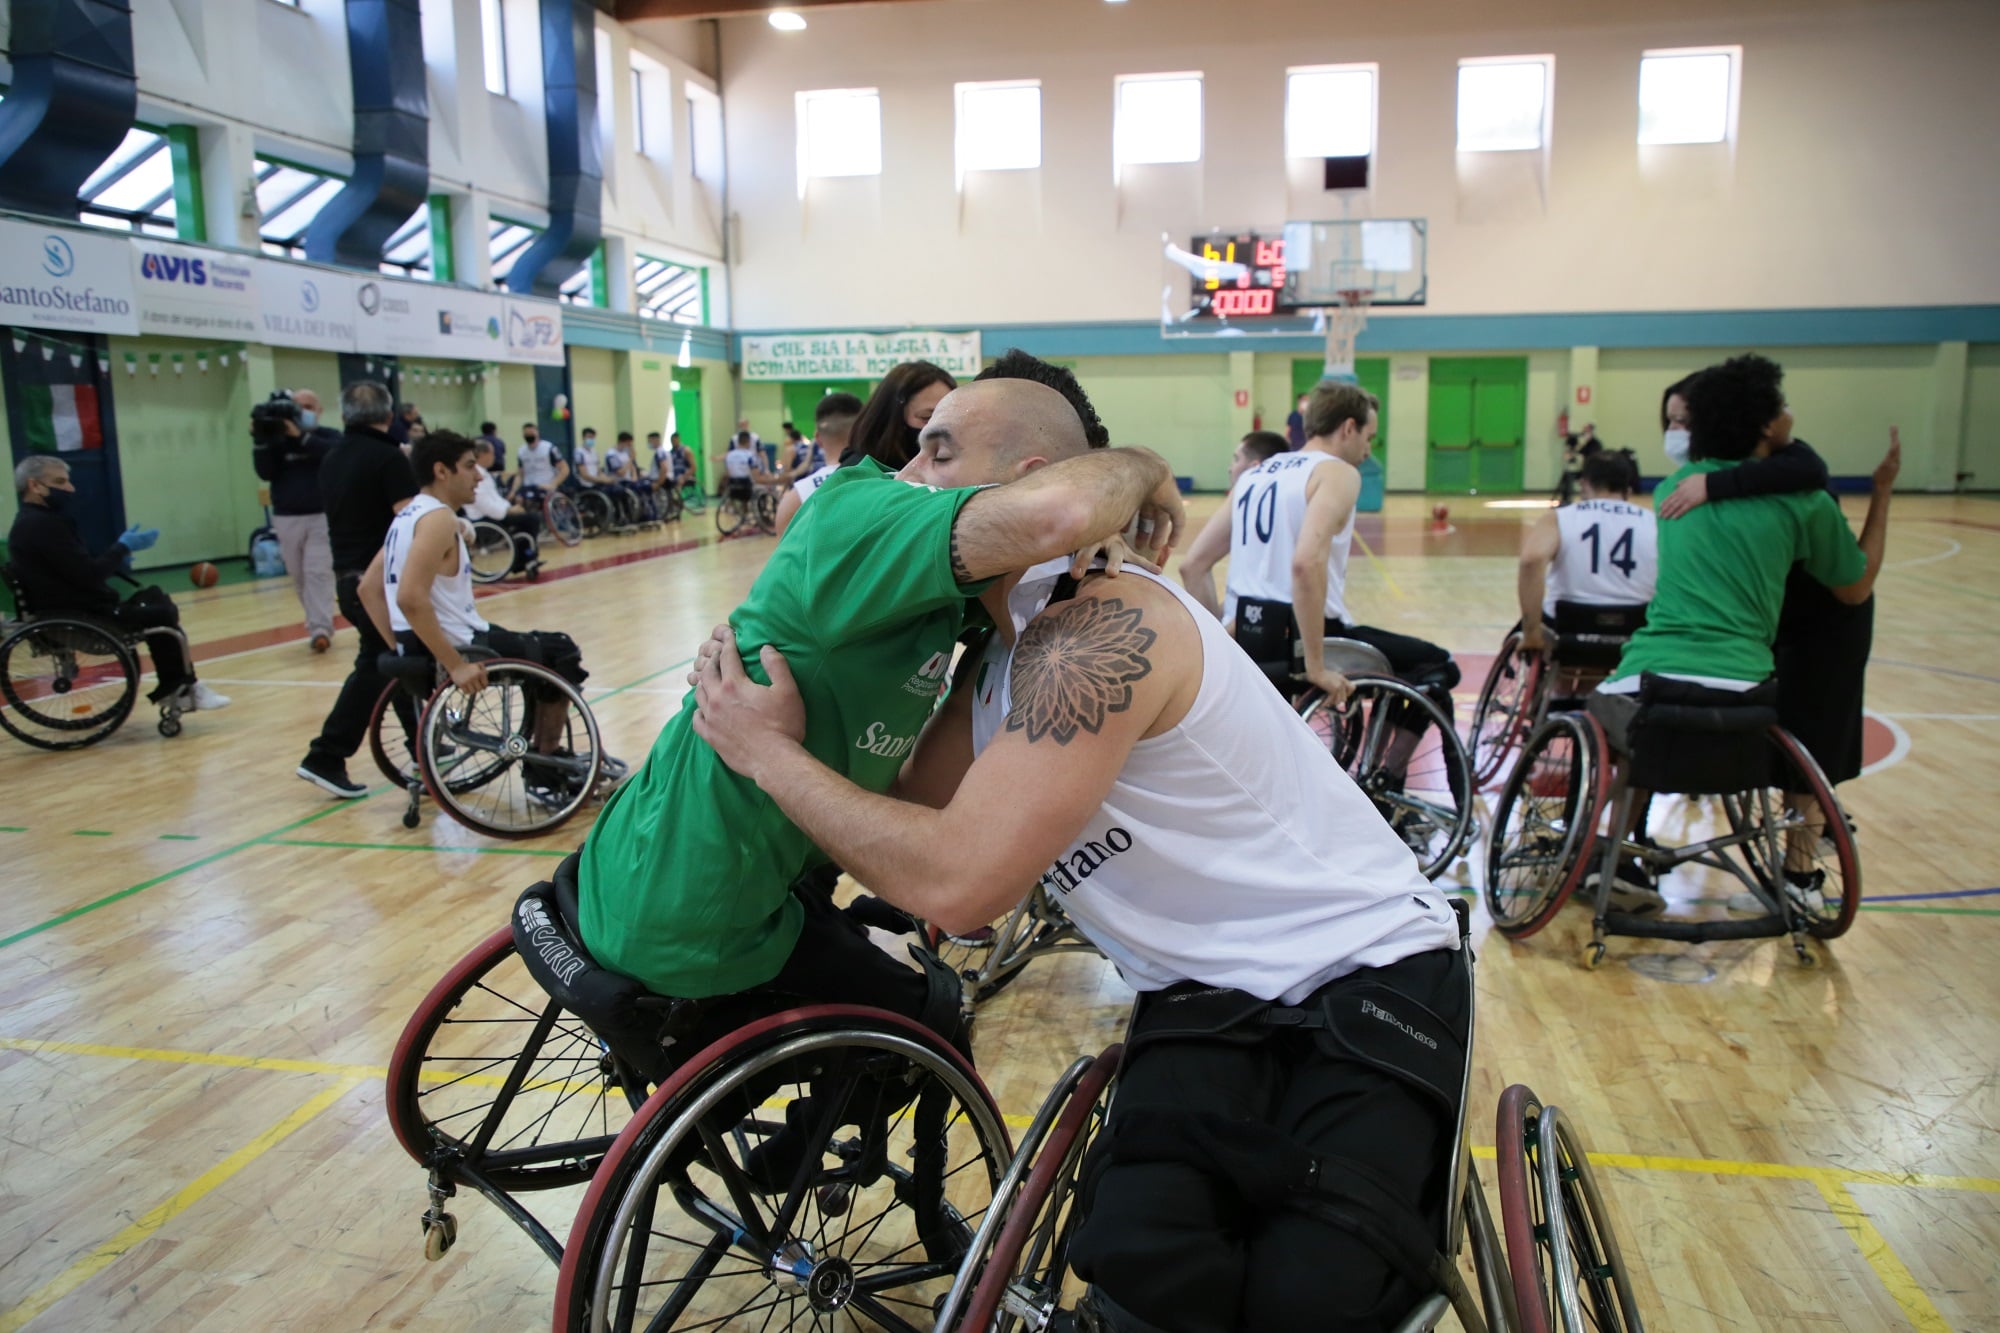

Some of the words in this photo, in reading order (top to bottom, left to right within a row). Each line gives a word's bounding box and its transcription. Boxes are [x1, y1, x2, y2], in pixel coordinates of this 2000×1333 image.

[141, 252, 207, 286] AVIS
[0, 285, 130, 316] antoStefano
[772, 341, 805, 357] CHE
[846, 338, 869, 354] LA
[937, 337, 949, 353] A
[1237, 480, 1278, 545] 10
[1580, 521, 1638, 579] 14
